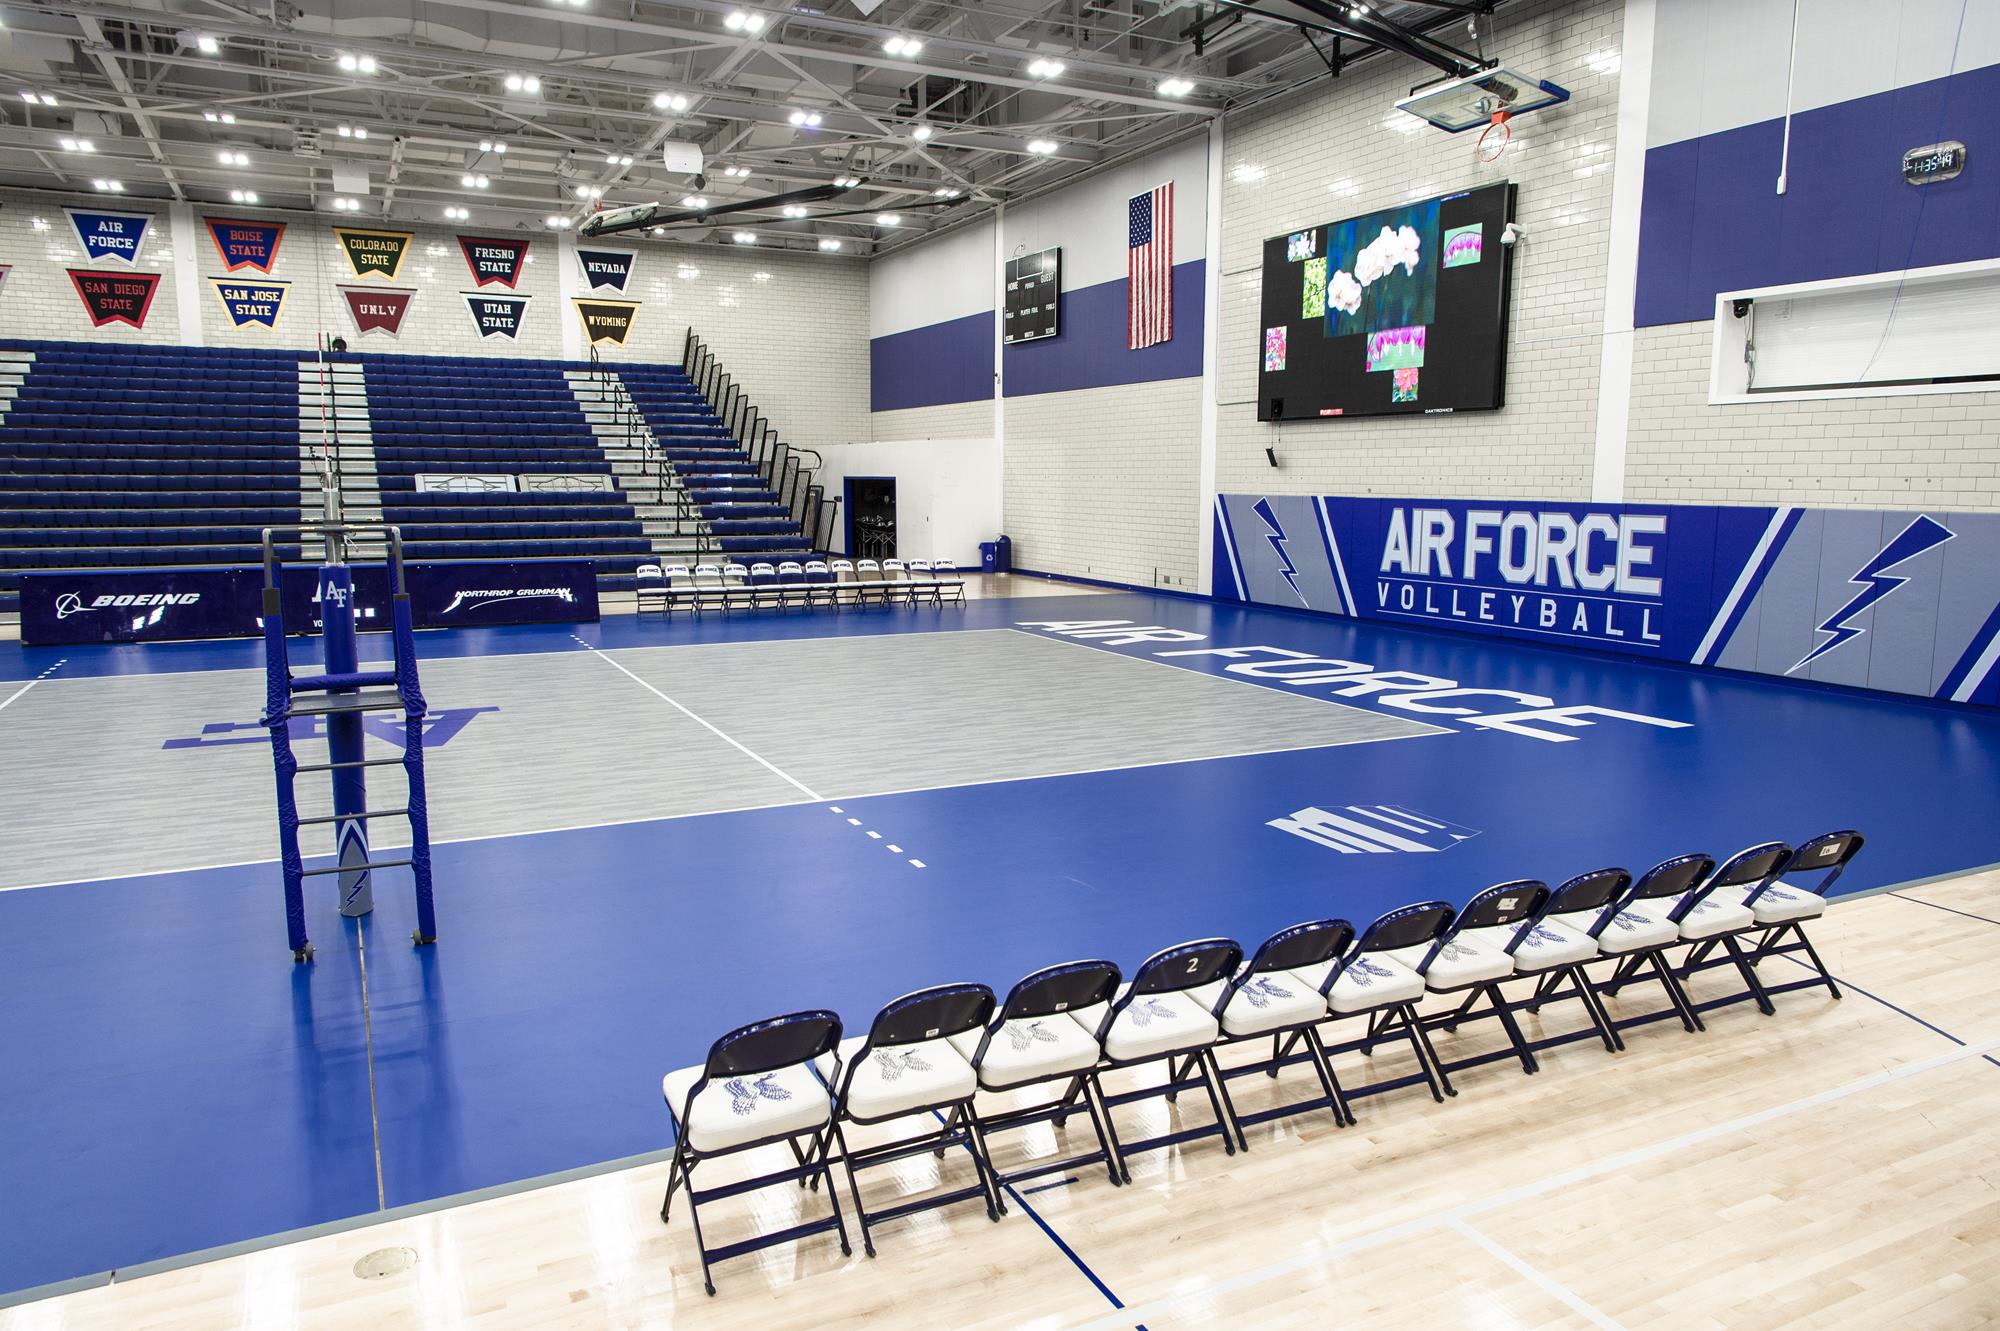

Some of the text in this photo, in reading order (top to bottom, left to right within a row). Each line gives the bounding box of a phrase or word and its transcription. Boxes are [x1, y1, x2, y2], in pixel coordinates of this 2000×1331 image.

[98, 221, 123, 233] AIR
[88, 236, 134, 249] FORCE
[230, 230, 263, 242] BOISE
[229, 244, 266, 257] STATE
[350, 239, 399, 252] COLORADO
[361, 253, 389, 266] STATE
[475, 247, 515, 260] FRESNO
[479, 261, 512, 273] STATE
[588, 262, 626, 275] NEVADA
[85, 282, 145, 296] SAN DIEGO
[224, 289, 280, 303] SAN JOSE
[100, 297, 133, 310] STATE
[360, 304, 397, 316] UNLV
[484, 303, 512, 314] UTAH
[235, 304, 272, 317] STATE
[482, 317, 514, 328] STATE
[588, 315, 627, 327] WYOMING
[1380, 508, 1667, 596] AIR FORCE
[325, 581, 347, 607] AF
[455, 588, 571, 598] NORTHROP GRUMMAN
[91, 593, 200, 607] BOEING
[1377, 582, 1661, 640] VOLLEYBALL
[1014, 620, 1694, 742] AIR FORCE
[1186, 957, 1199, 973] 2
